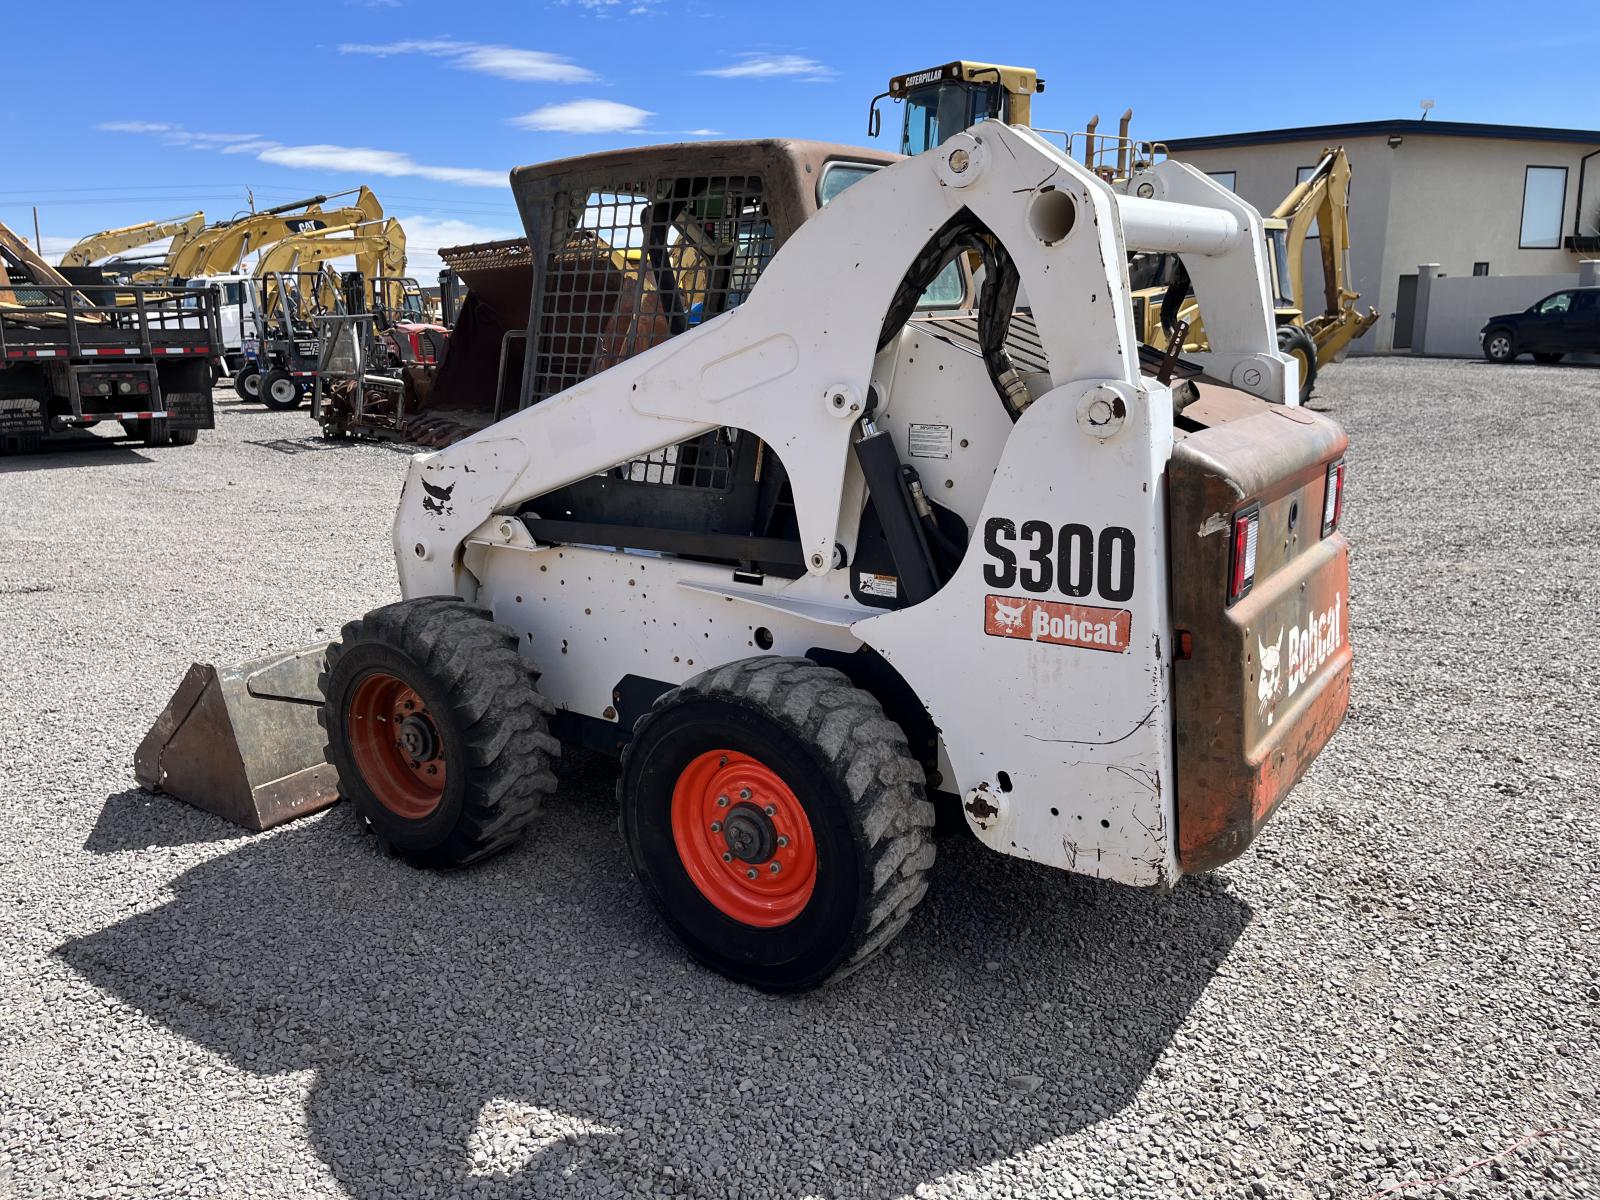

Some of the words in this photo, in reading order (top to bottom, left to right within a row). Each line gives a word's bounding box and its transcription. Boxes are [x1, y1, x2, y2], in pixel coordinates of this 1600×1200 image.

[905, 69, 943, 87] CATERPILLAR
[298, 220, 316, 233] CAT
[983, 517, 1136, 602] S300
[1034, 607, 1118, 646] Bobcat
[1288, 591, 1341, 698] Bobcat
